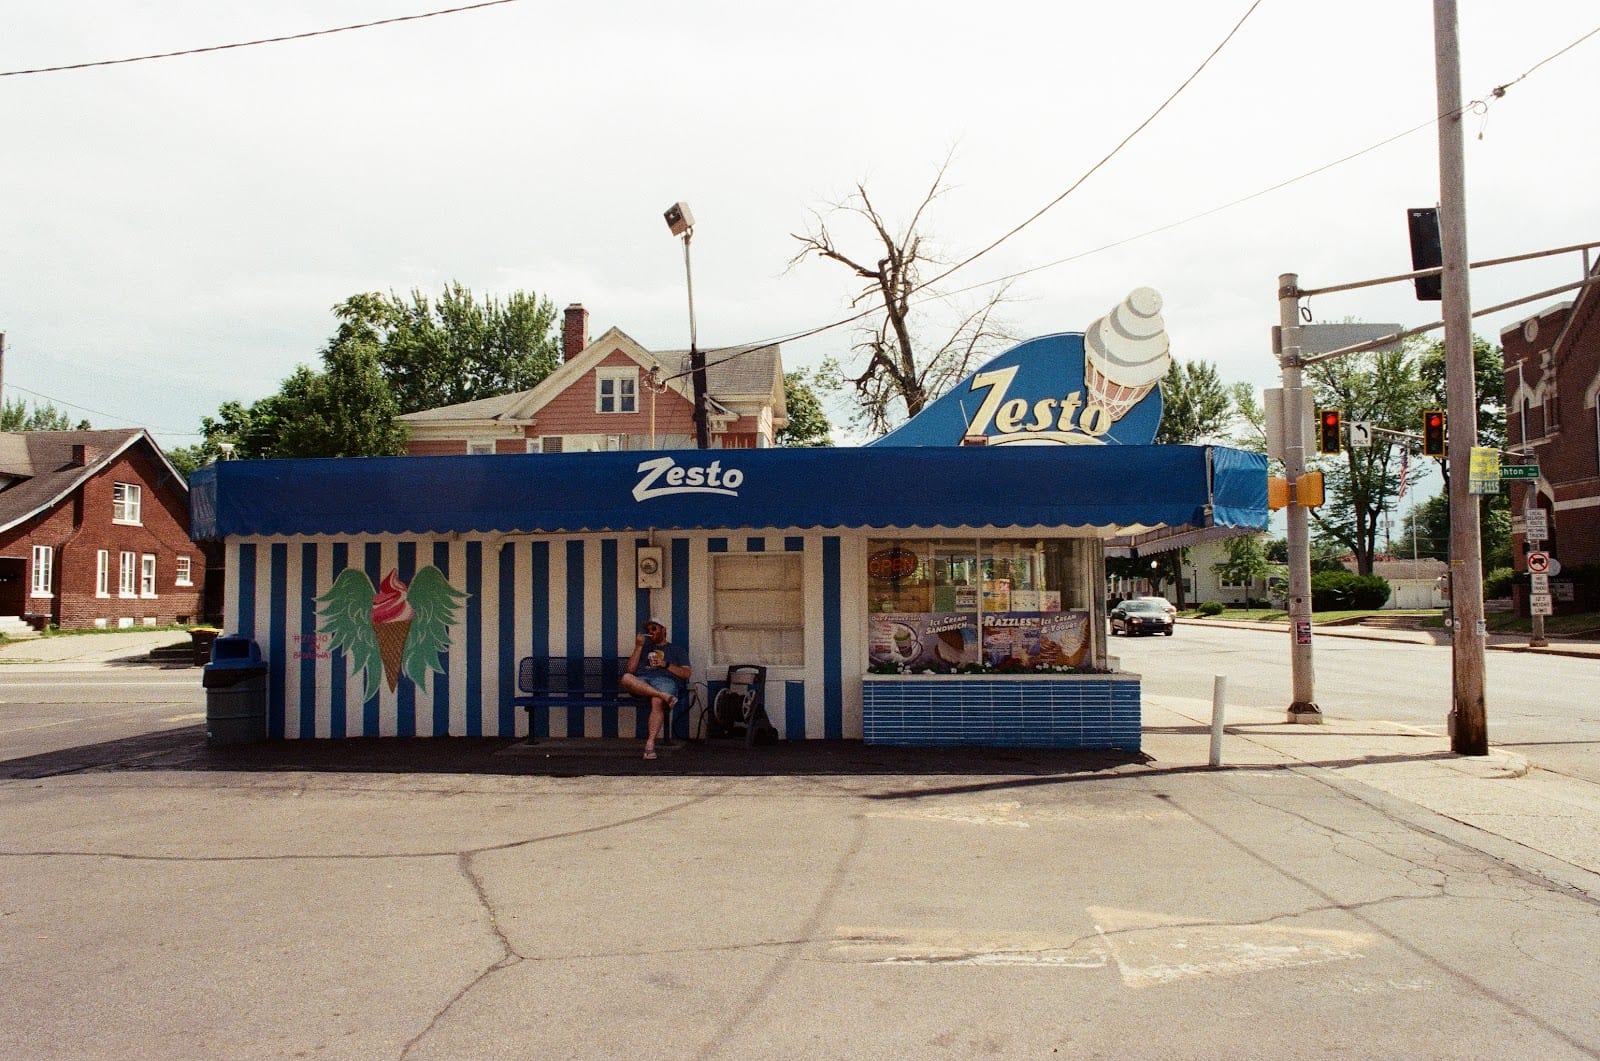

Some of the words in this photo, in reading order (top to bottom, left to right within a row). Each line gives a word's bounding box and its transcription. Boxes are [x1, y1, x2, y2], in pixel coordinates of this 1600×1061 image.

[960, 364, 1112, 446] Zesto
[1499, 467, 1524, 477] ghton
[632, 457, 744, 502] Zesto
[870, 558, 915, 572] OPEN
[944, 616, 968, 624] CREAM
[984, 615, 1032, 627] RAZZLES
[926, 622, 968, 635] SANDWICH
